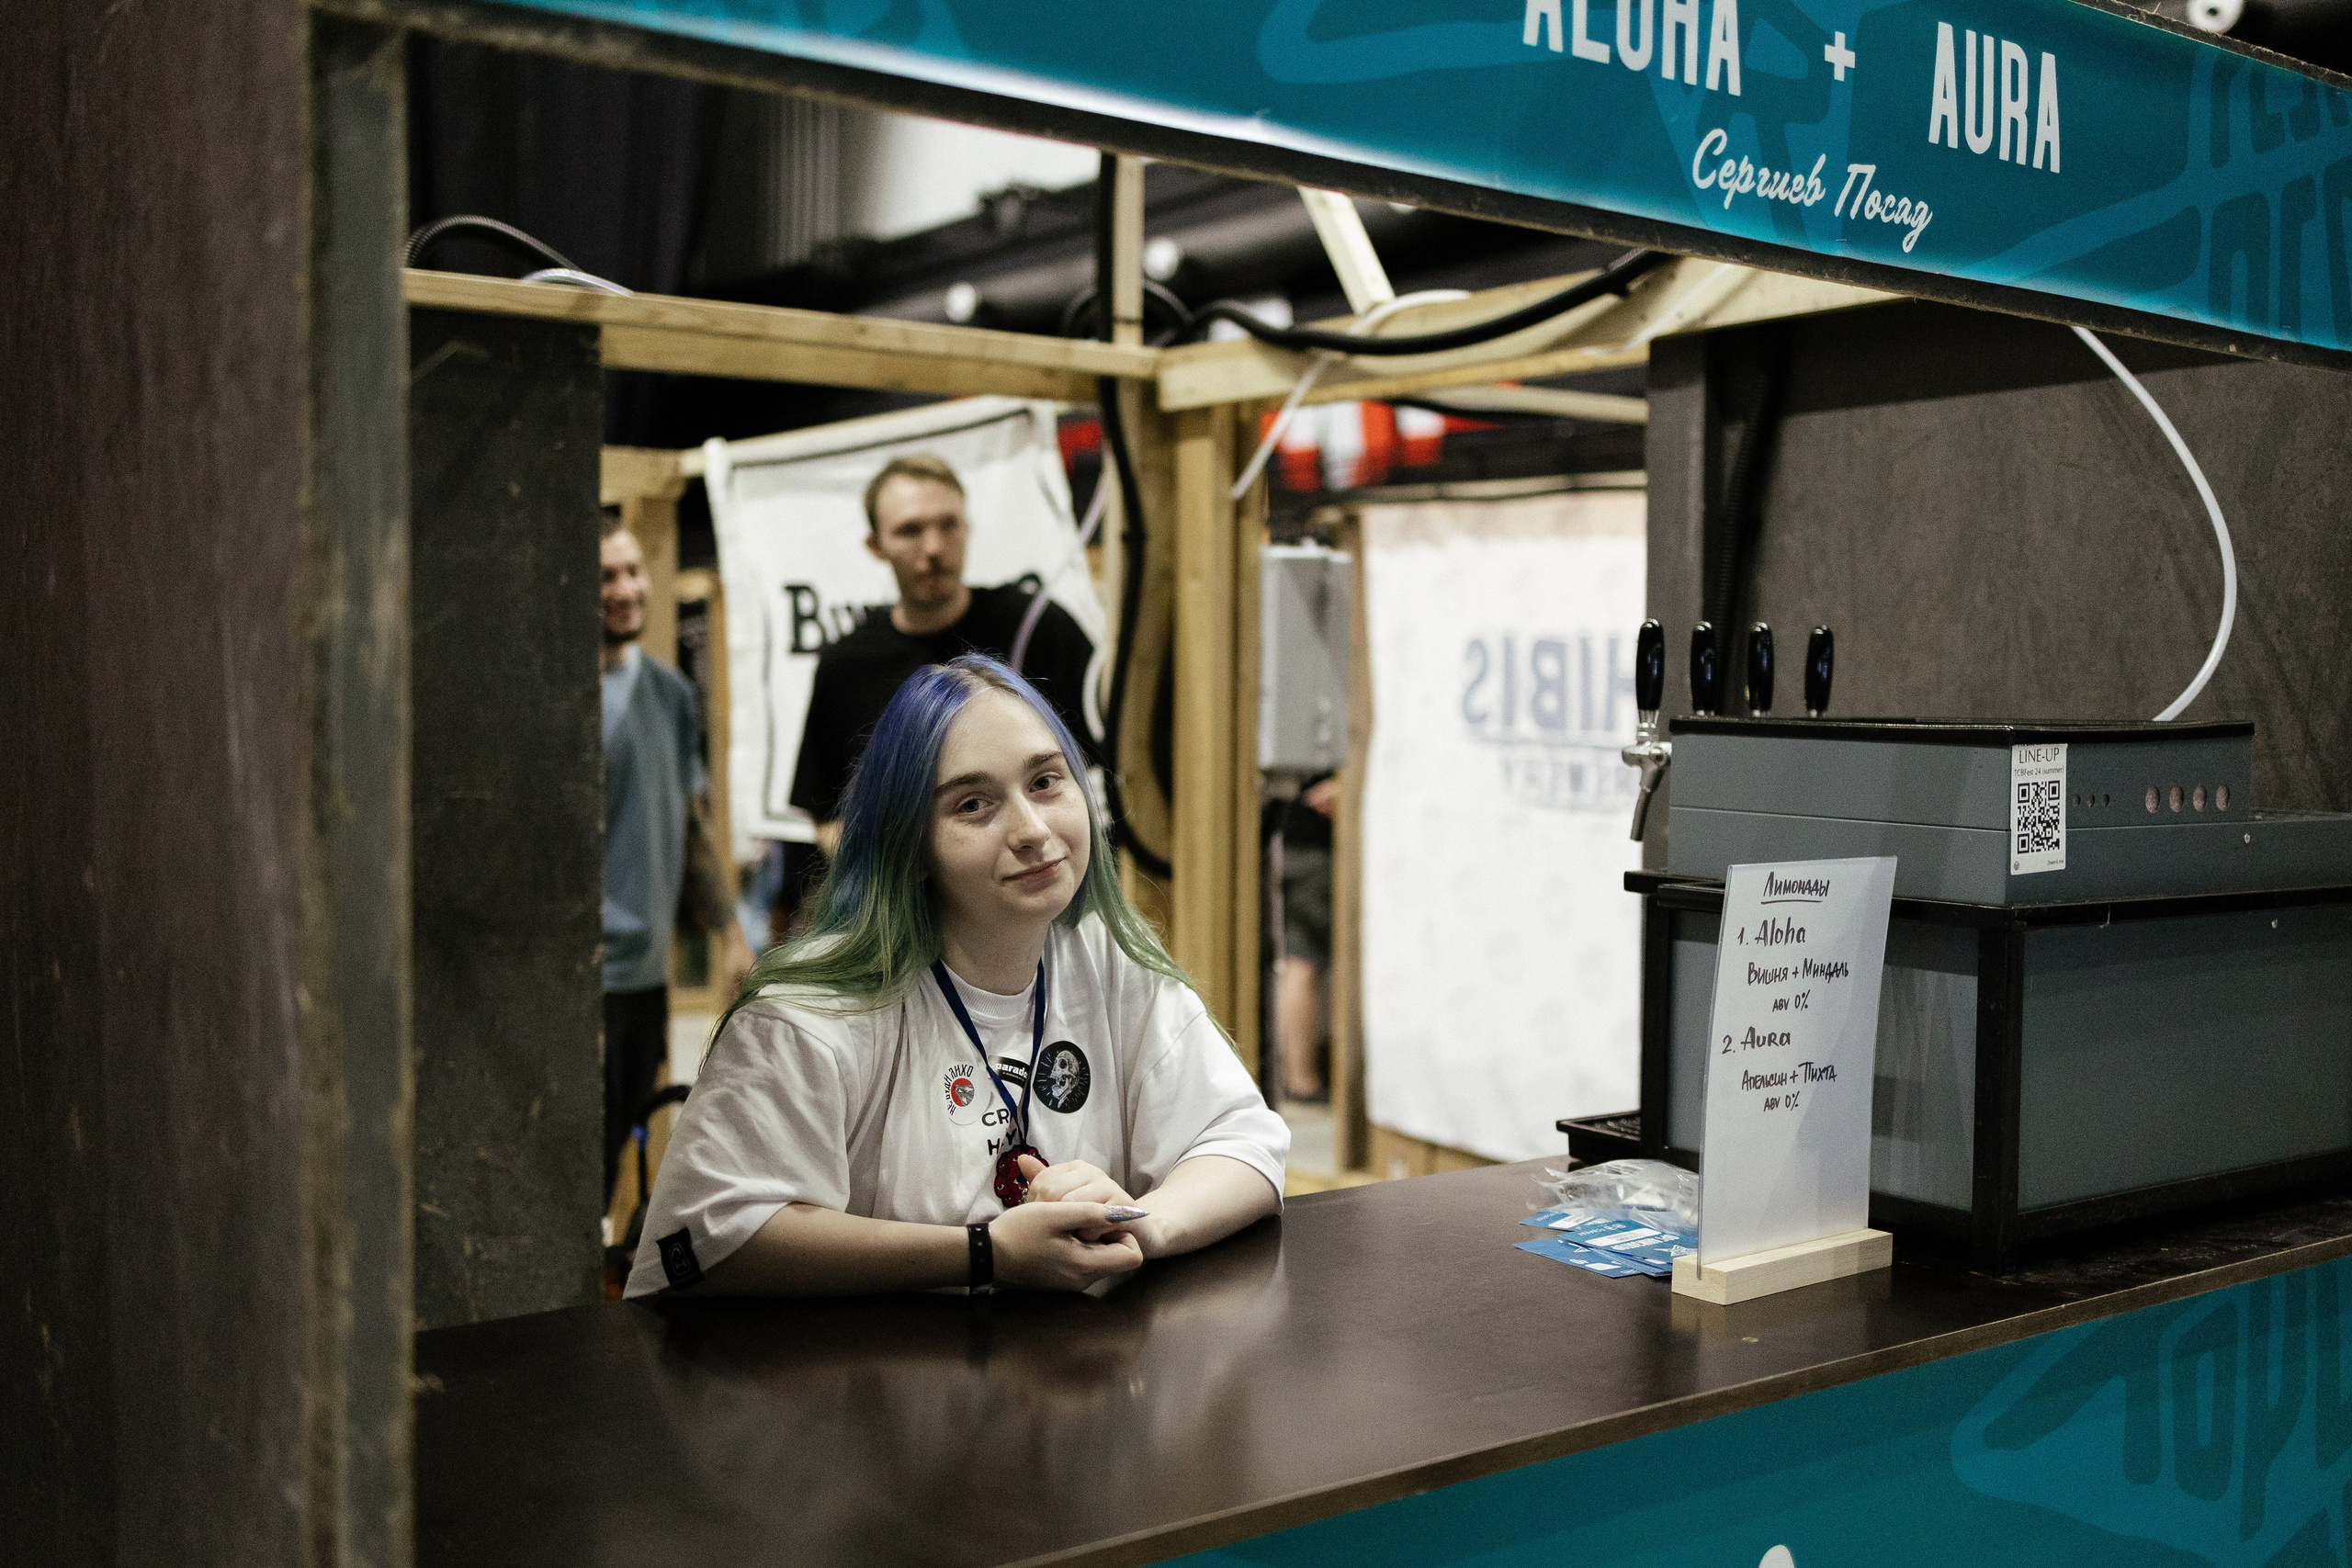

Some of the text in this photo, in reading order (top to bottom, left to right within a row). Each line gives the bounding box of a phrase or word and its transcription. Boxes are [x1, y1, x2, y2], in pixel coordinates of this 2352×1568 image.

[1928, 21, 2061, 174] AURA
[1691, 128, 1934, 254] Сергиев Посад
[2018, 747, 2060, 764] LINE-UP
[2035, 767, 2041, 775] 24
[2042, 766, 2064, 775] (summer)
[1737, 916, 1806, 947] 1. Aloha
[1794, 989, 1811, 1011] 0%
[1722, 1034, 1736, 1055] 2.
[1785, 1090, 1801, 1111] 0%
